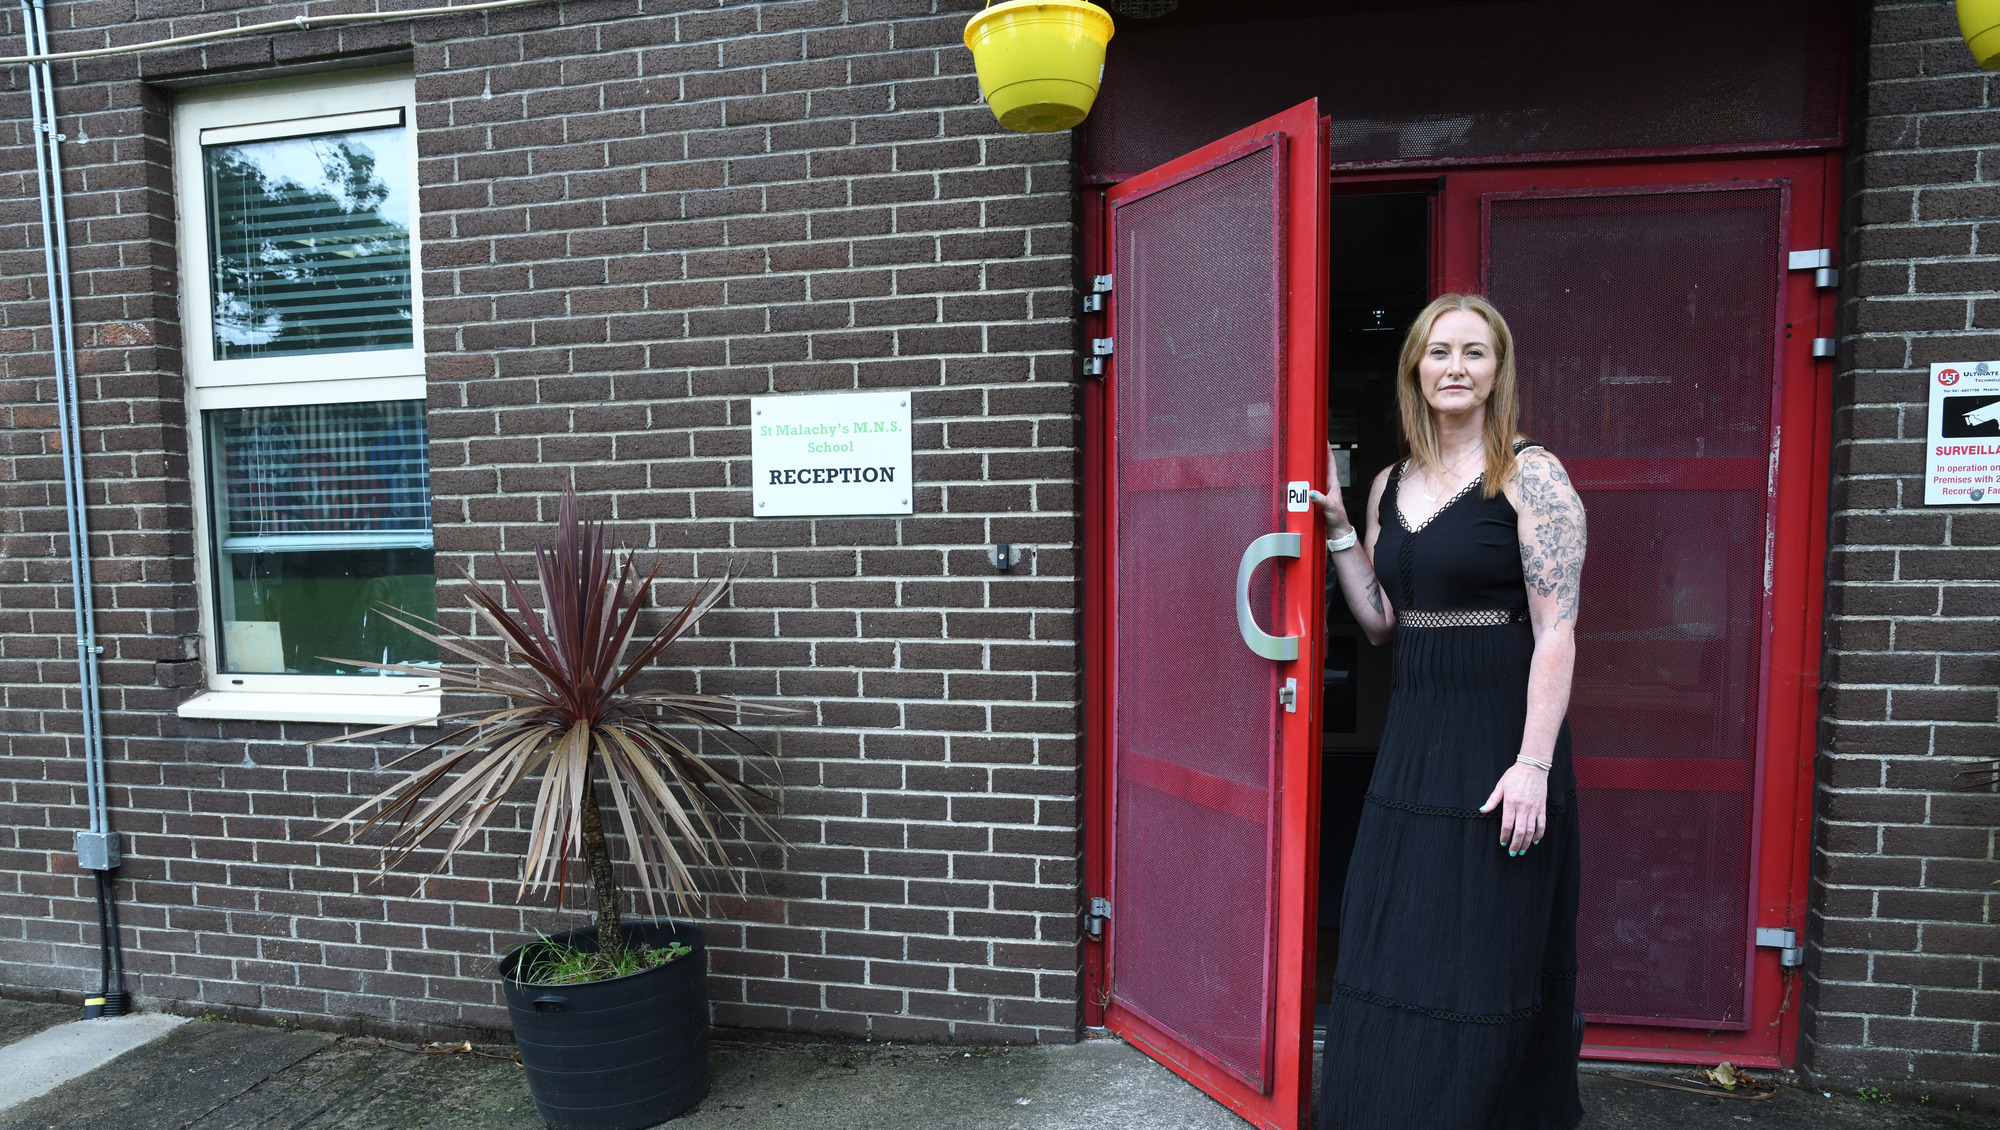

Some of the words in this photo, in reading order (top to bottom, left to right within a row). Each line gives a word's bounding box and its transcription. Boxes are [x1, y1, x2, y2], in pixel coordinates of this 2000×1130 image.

[760, 425, 772, 437] St
[775, 423, 850, 437] Malachy's
[853, 420, 902, 434] M.N.S.
[807, 441, 854, 453] School
[1947, 464, 1988, 473] operation
[769, 467, 896, 486] RECEPTION
[1933, 476, 1972, 484] Premises
[1975, 475, 1993, 483] with
[1289, 489, 1307, 504] Pull
[1942, 487, 1985, 496] Recordg
